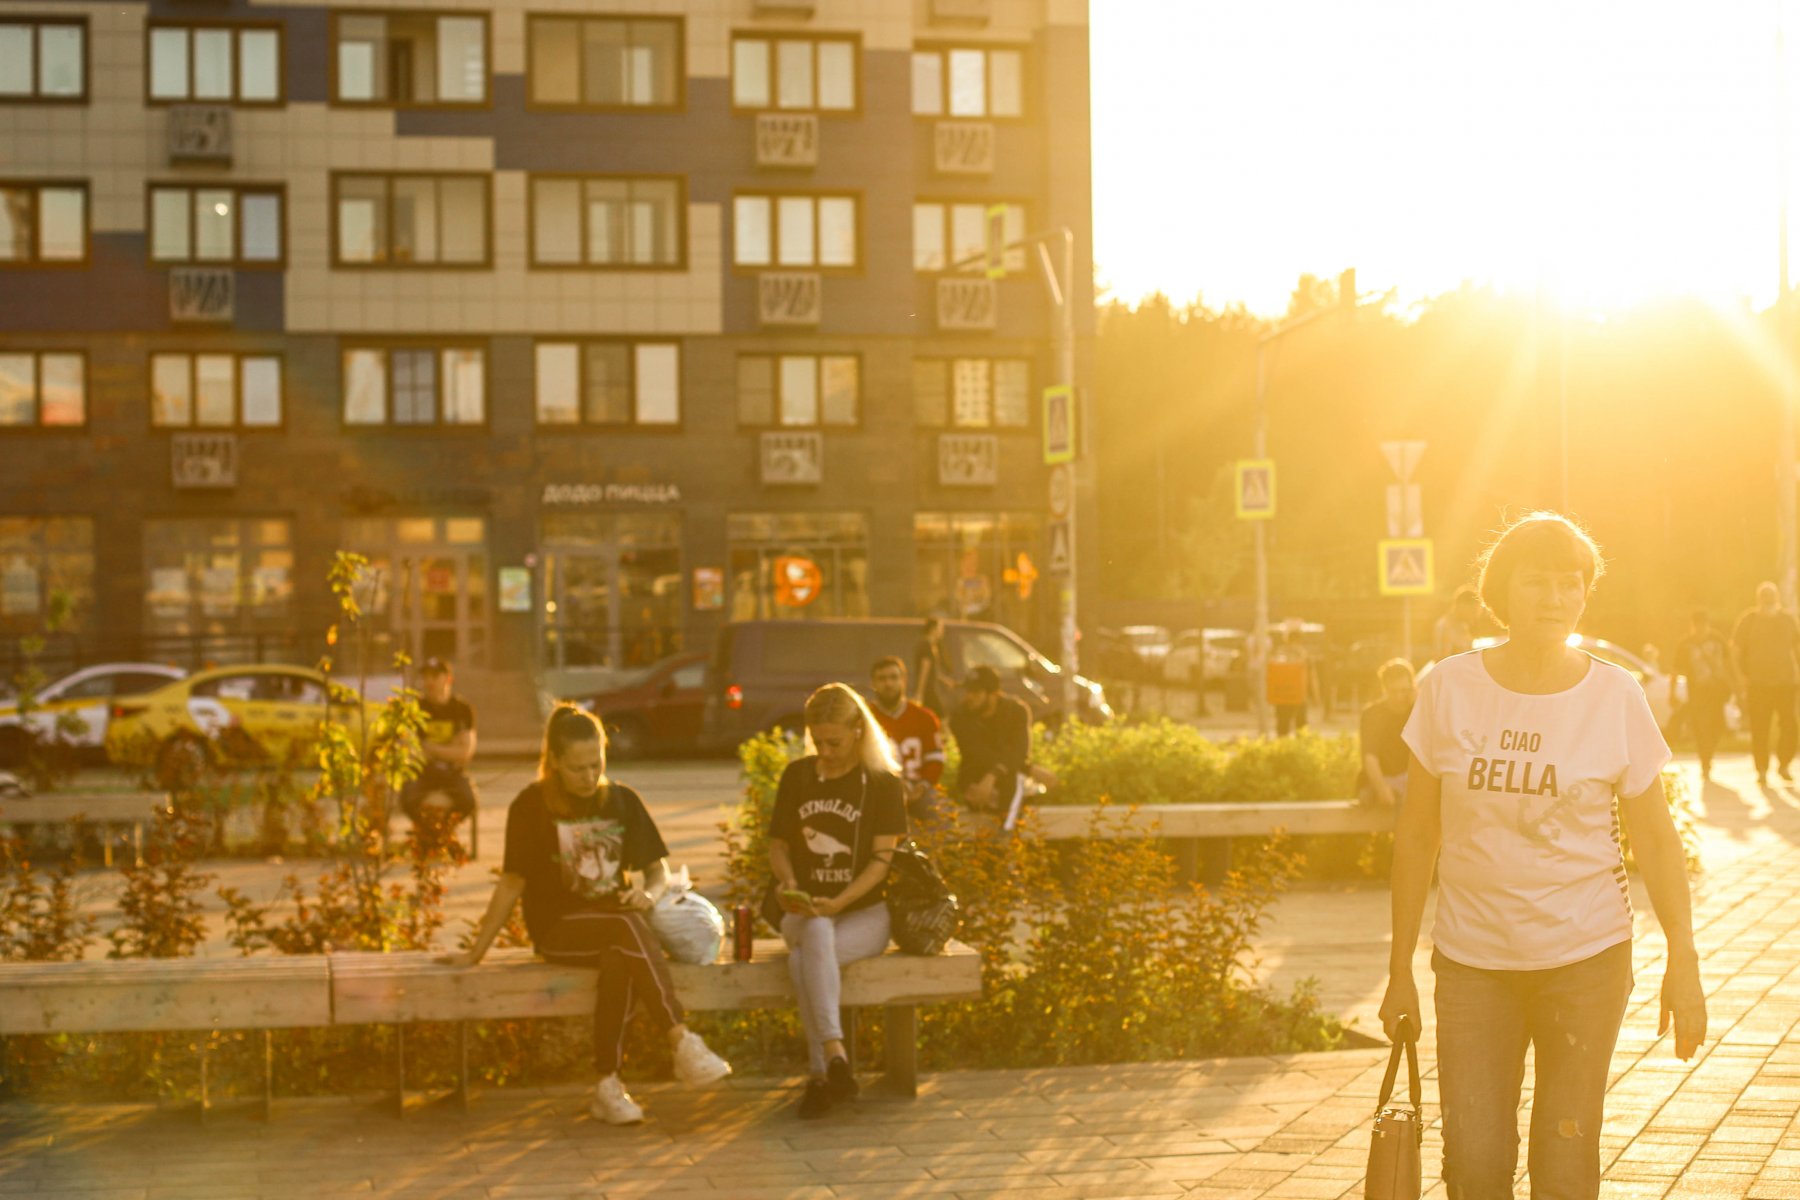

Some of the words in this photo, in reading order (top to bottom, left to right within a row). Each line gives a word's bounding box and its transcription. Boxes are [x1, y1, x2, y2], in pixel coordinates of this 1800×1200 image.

[1500, 729, 1541, 753] CIAO
[1467, 757, 1558, 797] BELLA
[798, 799, 862, 823] EYNOLDS
